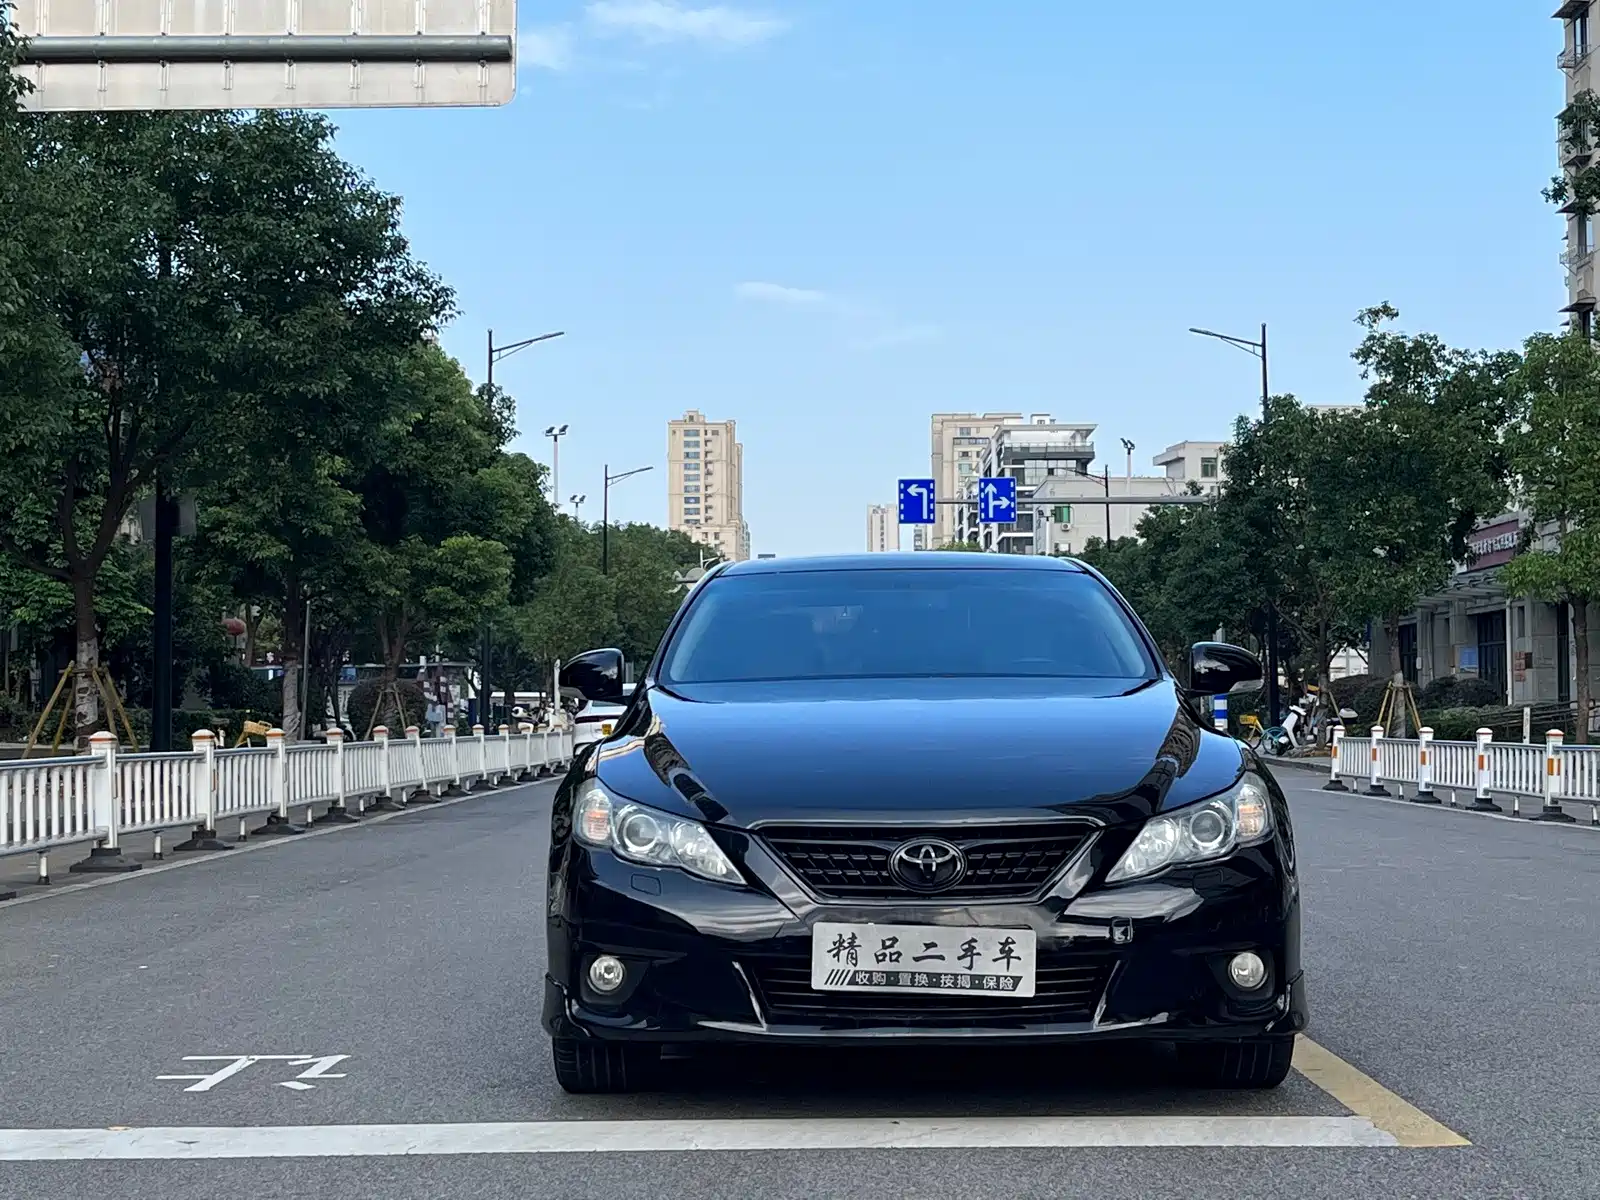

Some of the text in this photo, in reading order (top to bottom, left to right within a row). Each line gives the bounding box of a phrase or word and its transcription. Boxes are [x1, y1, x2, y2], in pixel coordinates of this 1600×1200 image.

[826, 932, 1022, 972] 精品二手车
